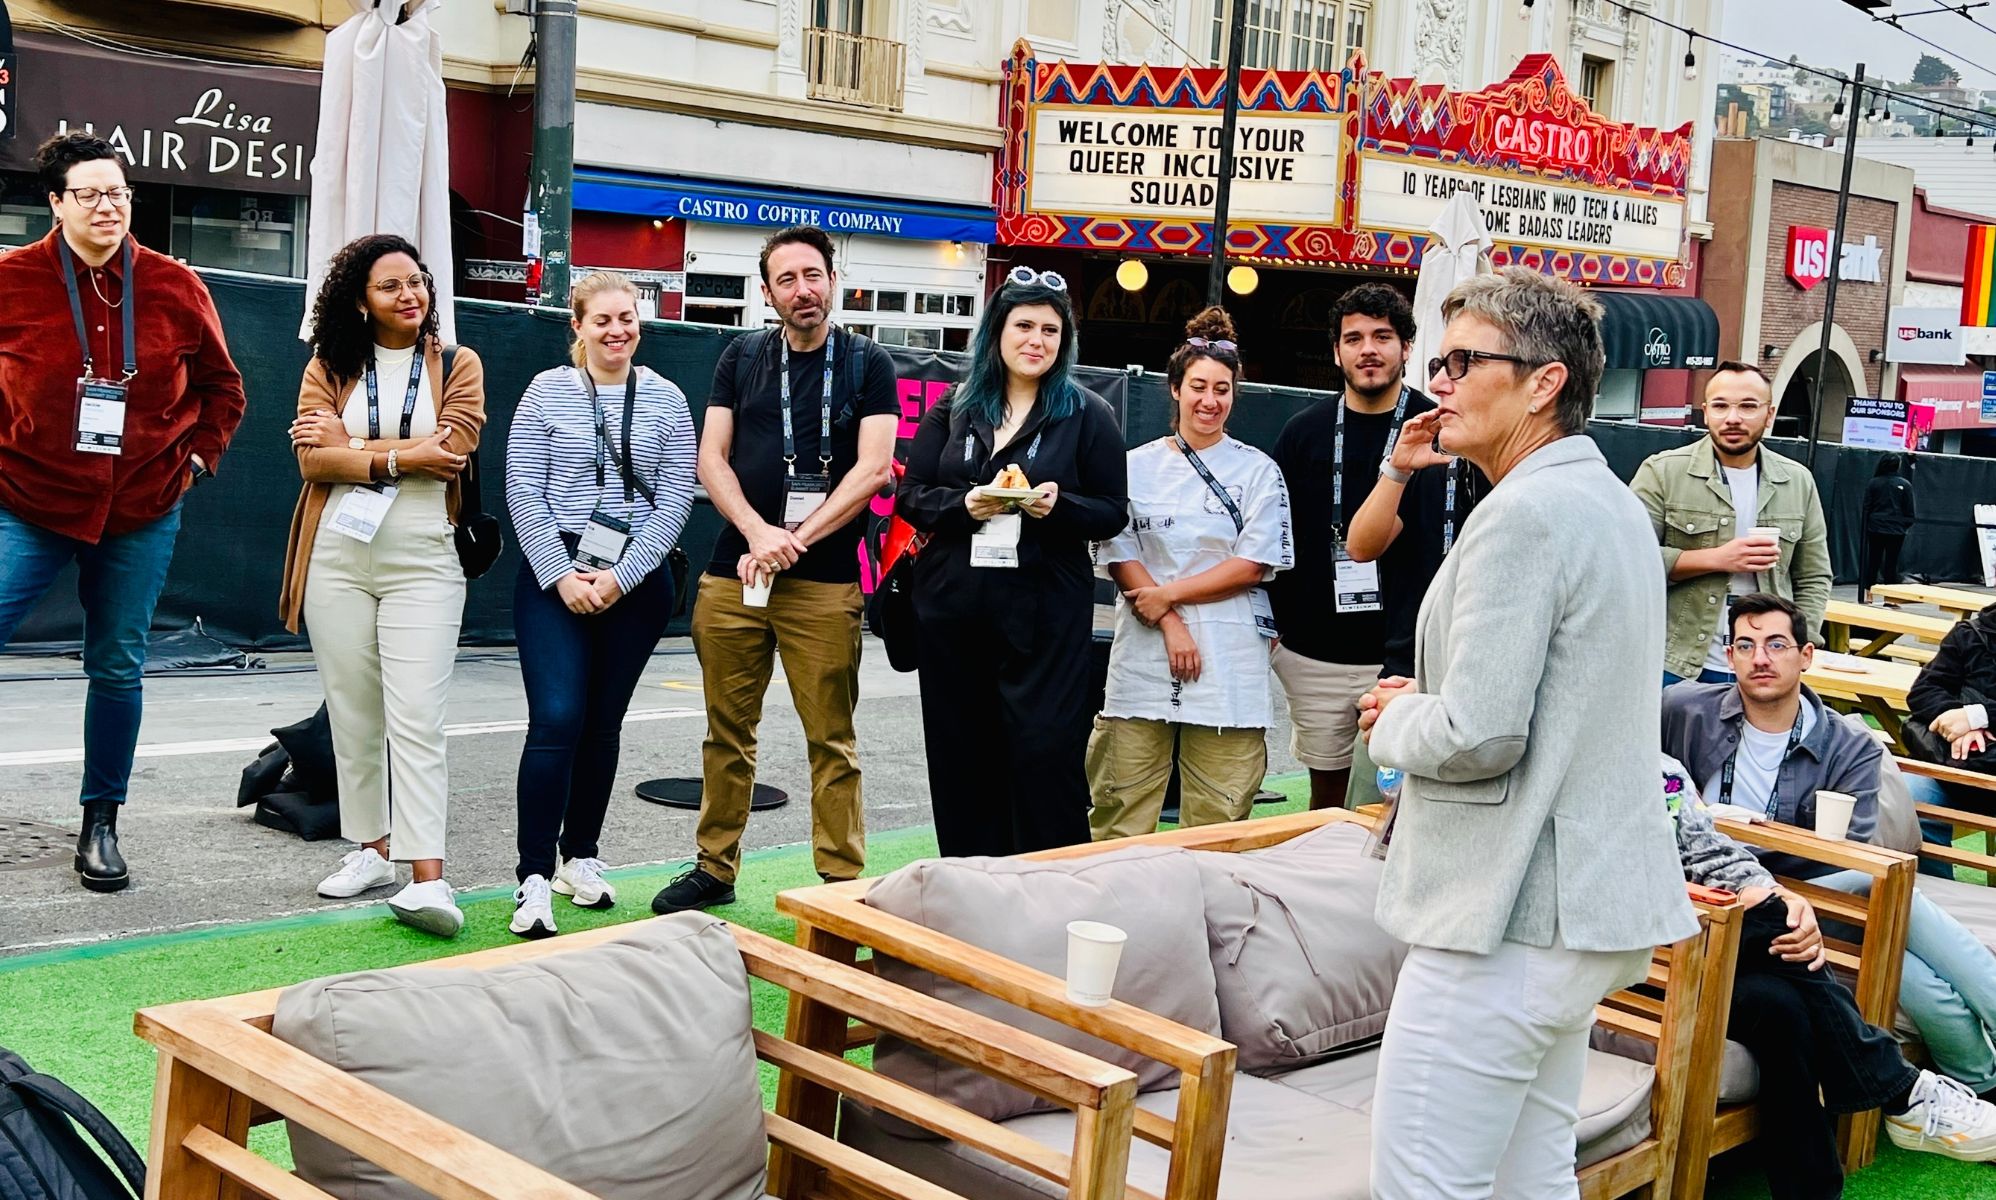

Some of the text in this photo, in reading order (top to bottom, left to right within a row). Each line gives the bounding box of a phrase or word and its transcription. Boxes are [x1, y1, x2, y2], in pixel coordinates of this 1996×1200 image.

[175, 88, 272, 134] Lisa
[1059, 120, 1305, 153] WELCOME TO YOUR
[1495, 114, 1592, 164] CASTRO
[208, 136, 313, 181] DESI
[1069, 150, 1145, 175] QUEER
[1130, 181, 1214, 207] SQUAD
[1403, 171, 1658, 226] 10 YEARS OF LESBIANS WHO TECH & ALLIES
[678, 197, 903, 233] CASTRO COFFEE COMPANY
[1480, 209, 1612, 245] OME BADASS LEADERS
[1867, 408, 1905, 418] SPONSORS
